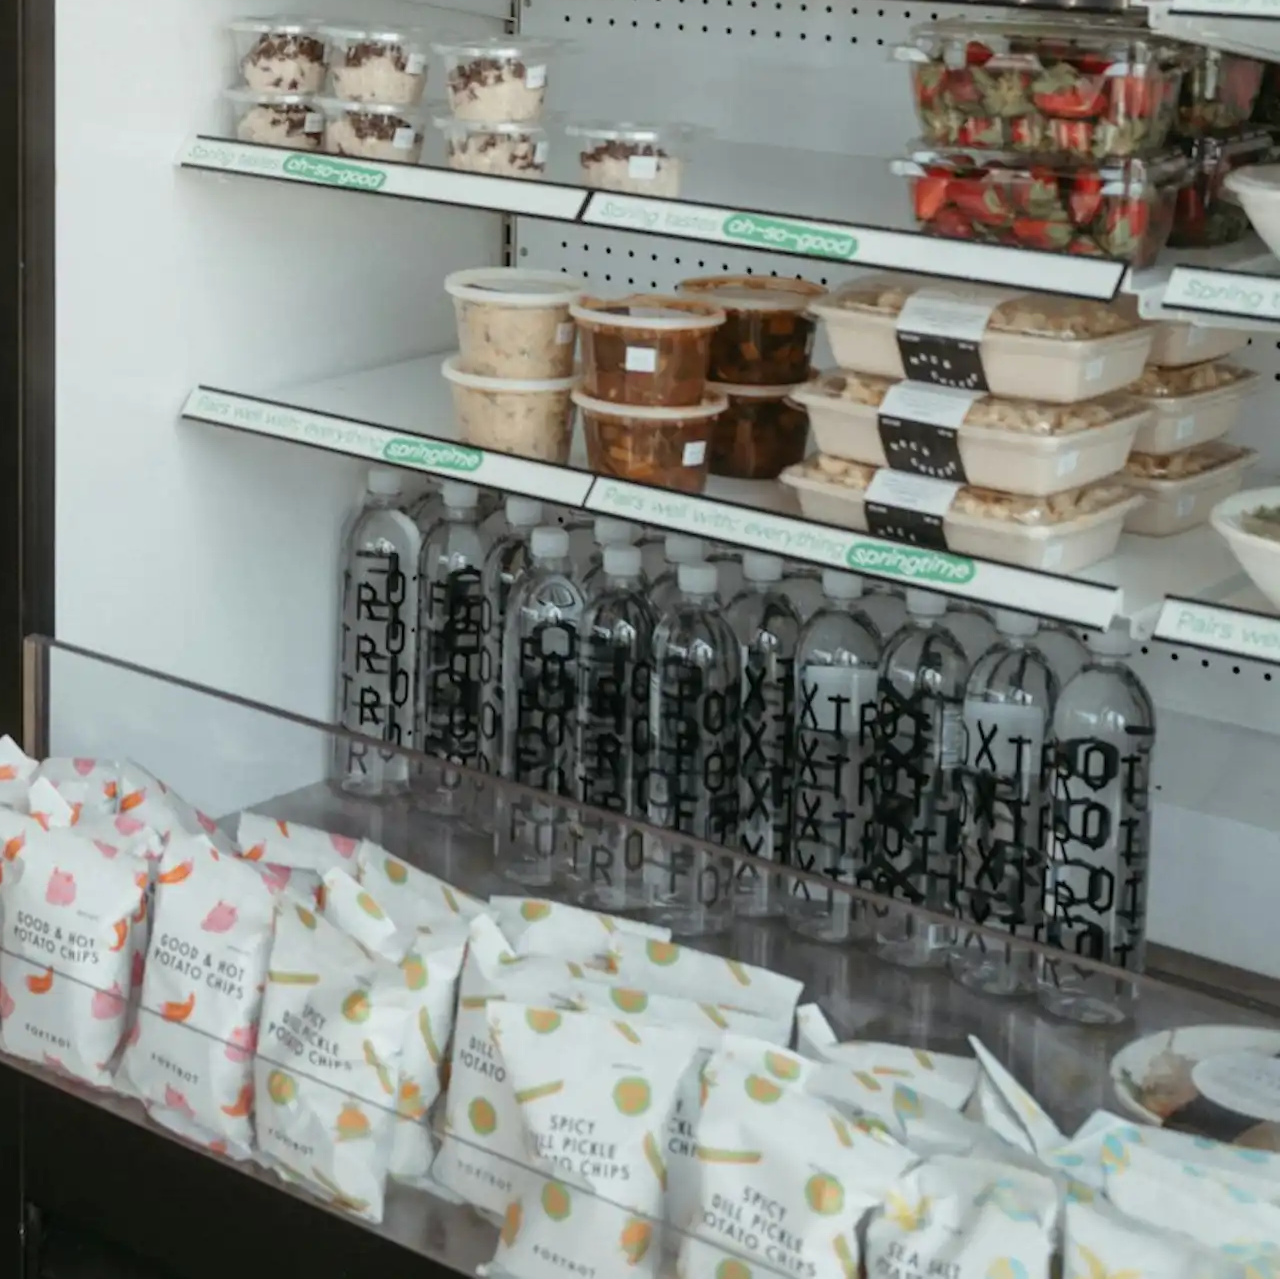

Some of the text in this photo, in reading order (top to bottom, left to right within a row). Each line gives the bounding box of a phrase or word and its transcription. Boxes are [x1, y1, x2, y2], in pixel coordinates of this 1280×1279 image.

[286, 156, 386, 187] oh-so-good
[728, 219, 854, 255] oh-so-good
[387, 440, 481, 468] springtime
[851, 542, 971, 580] springtime
[14, 926, 100, 965] POTATO CHIPS
[17, 909, 96, 949] GOOD & HOT
[154, 949, 244, 1000] POTATO CHIPS
[161, 933, 246, 981] GOOD & HOT
[550, 1114, 596, 1135] SPICY
[563, 1138, 617, 1160] PICKLE
[580, 1158, 631, 1182] CHIPS
[742, 1186, 787, 1222] SPICY
[712, 1193, 804, 1254] DILL PICKLE
[765, 1242, 817, 1279] CHIPS
[887, 1241, 918, 1267] SEA
